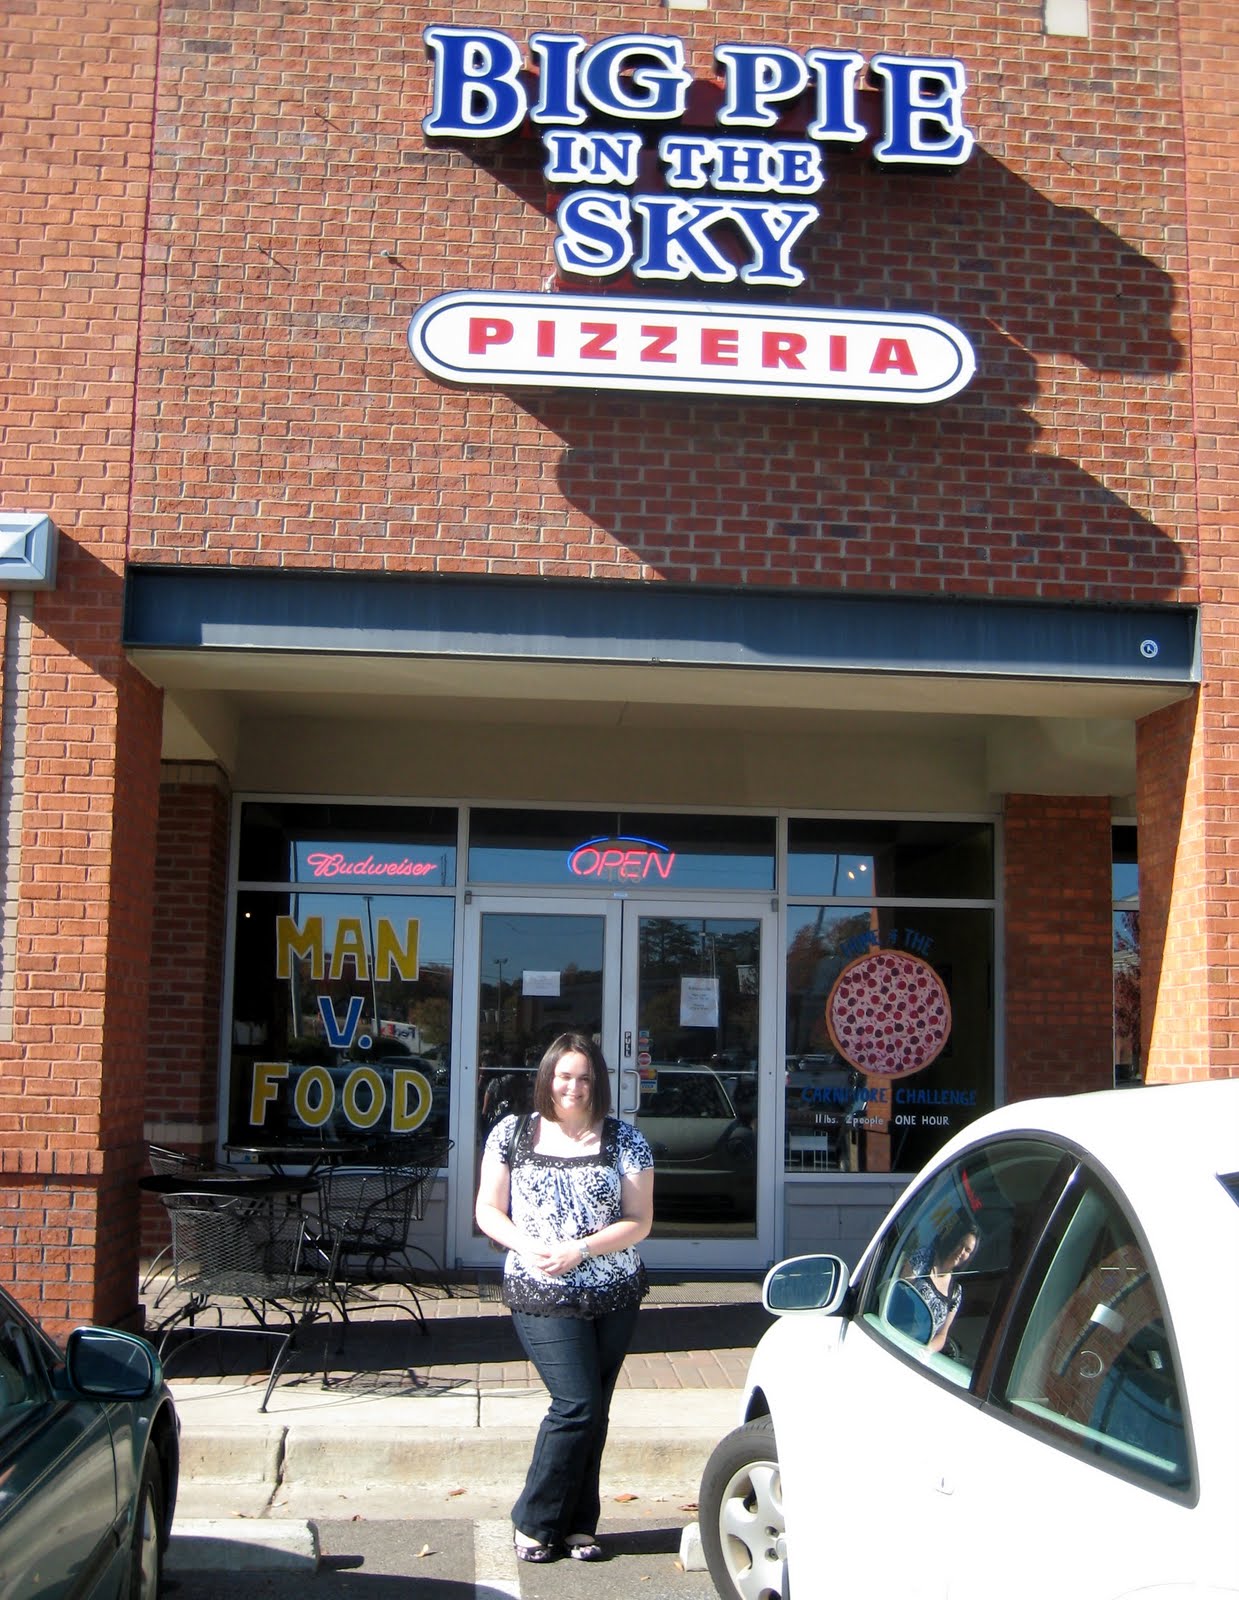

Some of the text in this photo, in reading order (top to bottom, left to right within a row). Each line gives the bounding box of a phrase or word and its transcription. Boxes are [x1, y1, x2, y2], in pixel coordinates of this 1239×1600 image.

[424, 26, 975, 166] BIG PIE
[545, 131, 826, 194] IN THE
[555, 190, 821, 287] SKY
[468, 316, 919, 377] PIZZERIA
[308, 853, 438, 877] Budweiser
[571, 847, 675, 878] OPEN
[275, 915, 420, 981] MAN
[904, 927, 935, 957] THE
[317, 996, 373, 1049] V.
[250, 1062, 433, 1132] FOOD
[895, 1087, 977, 1106] CHALLENGE
[895, 1115, 916, 1126] ONE
[921, 1115, 950, 1126] HOUR
